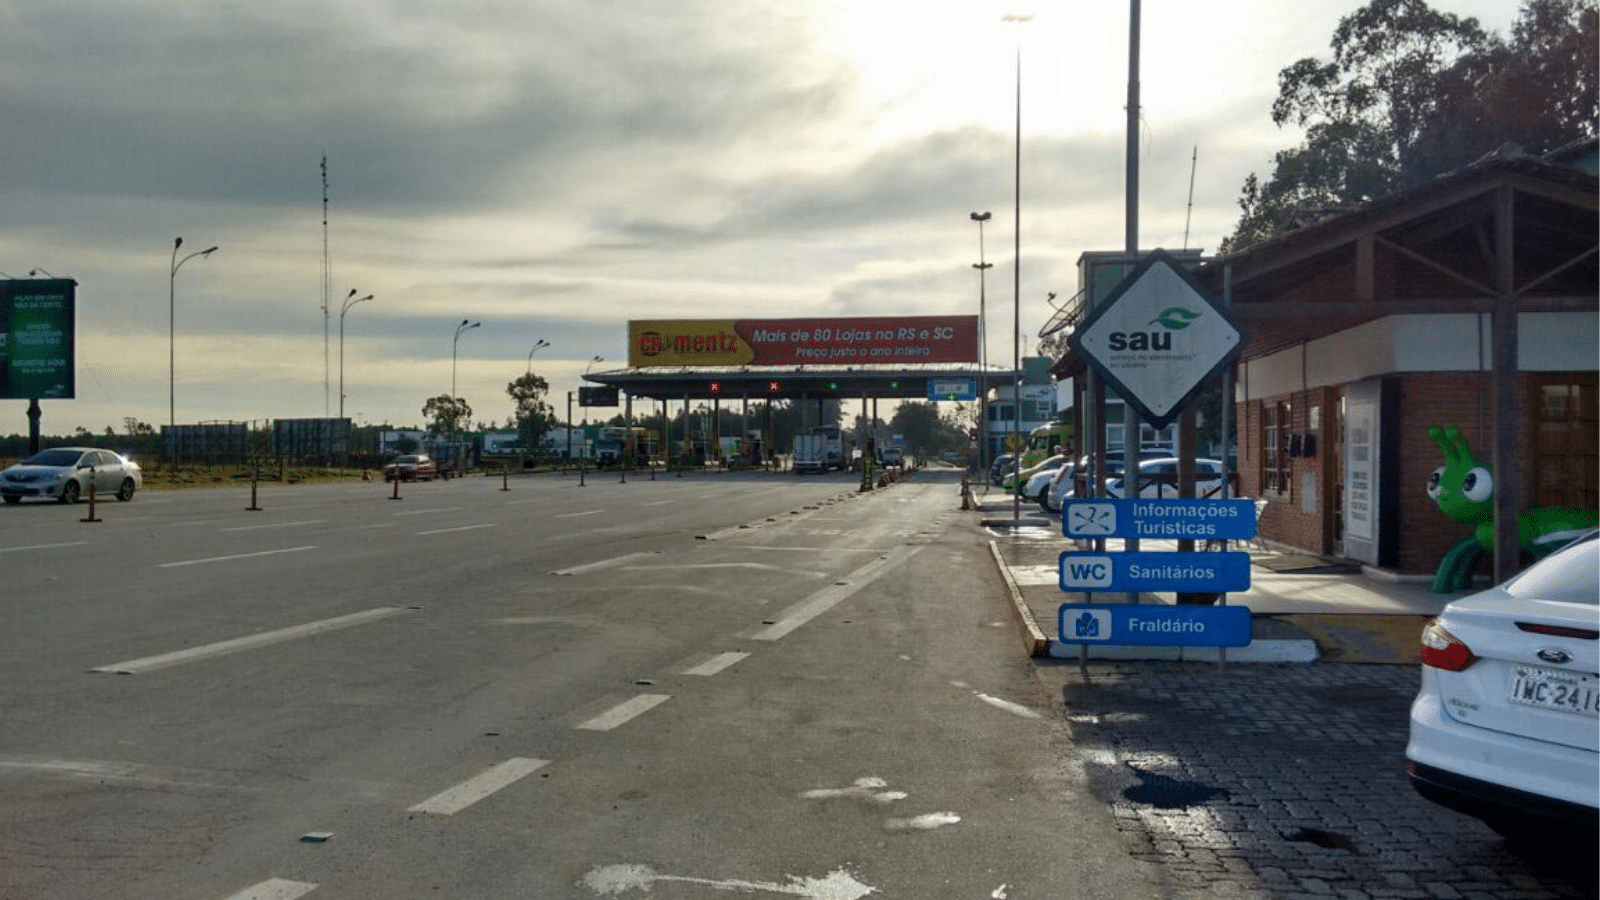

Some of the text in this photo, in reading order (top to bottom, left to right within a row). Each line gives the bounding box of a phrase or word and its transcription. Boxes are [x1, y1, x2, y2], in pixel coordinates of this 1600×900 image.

[753, 326, 954, 343] Mais de 80 Lojas no RS e SC
[1108, 331, 1172, 351] sau
[796, 346, 930, 358] Preço justo o ano inteiro
[1132, 503, 1238, 520] Informações
[1134, 520, 1216, 535] Turísticas
[1070, 563, 1106, 580] WC
[1129, 565, 1216, 580] Sanitários
[1128, 617, 1205, 633] Fraldário
